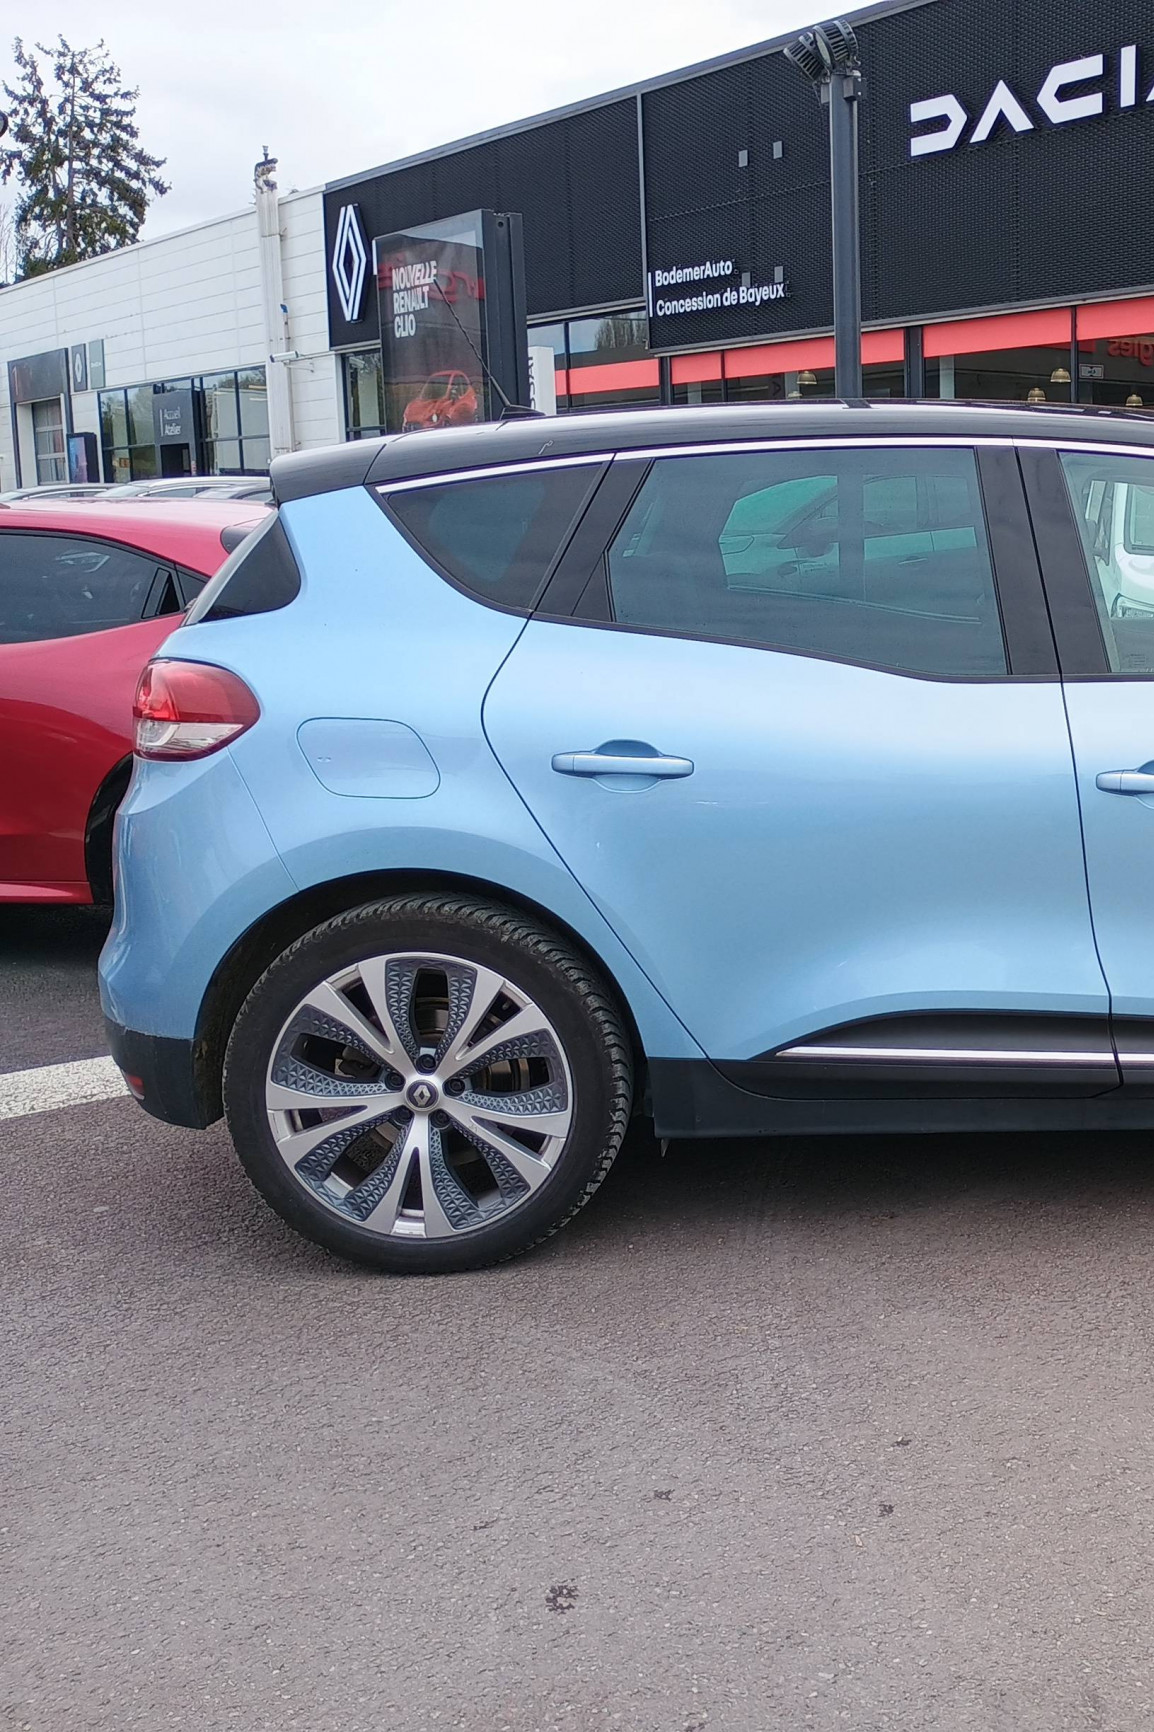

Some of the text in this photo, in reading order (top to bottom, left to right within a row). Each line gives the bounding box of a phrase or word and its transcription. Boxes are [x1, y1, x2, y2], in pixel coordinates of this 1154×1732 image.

[392, 261, 437, 290] NOUVELLE
[655, 260, 733, 287] BodemerAuto
[393, 286, 429, 314] RENAULT
[656, 283, 785, 316] Concession de Bayeux
[395, 314, 415, 338] CLIO
